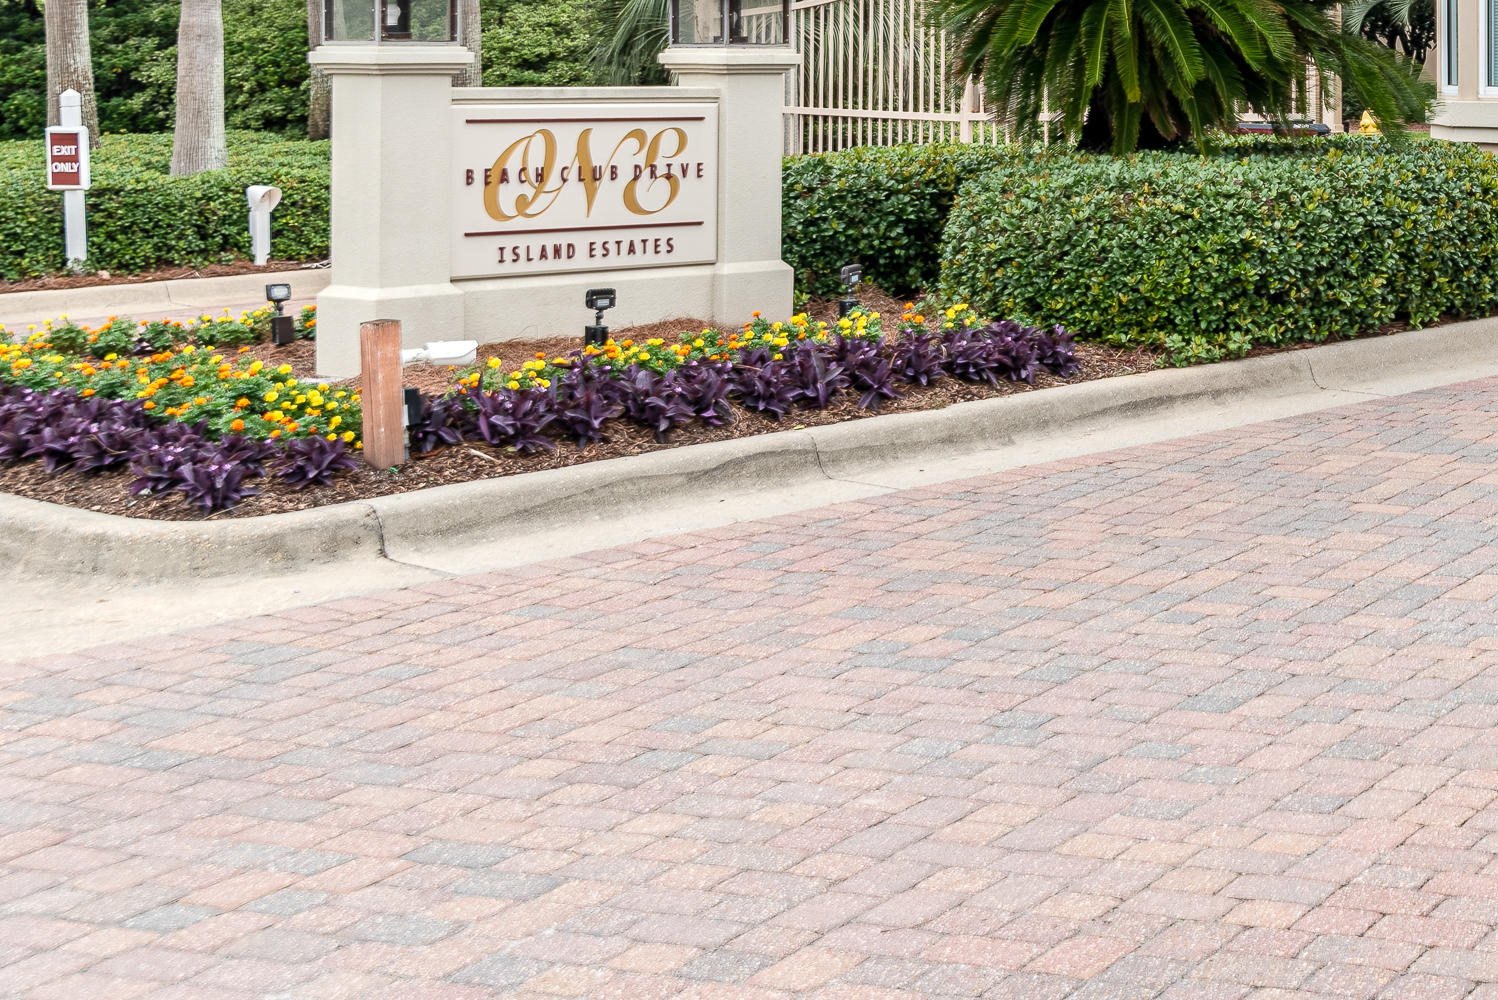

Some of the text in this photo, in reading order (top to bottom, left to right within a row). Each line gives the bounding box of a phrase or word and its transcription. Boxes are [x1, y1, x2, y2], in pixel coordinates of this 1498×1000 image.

[52, 145, 77, 156] EXIT
[52, 162, 79, 173] ONLY
[465, 162, 705, 186] BEACH CLUB DRIVE
[483, 127, 688, 222] ONE
[497, 237, 675, 264] ISLAND ESTATES
